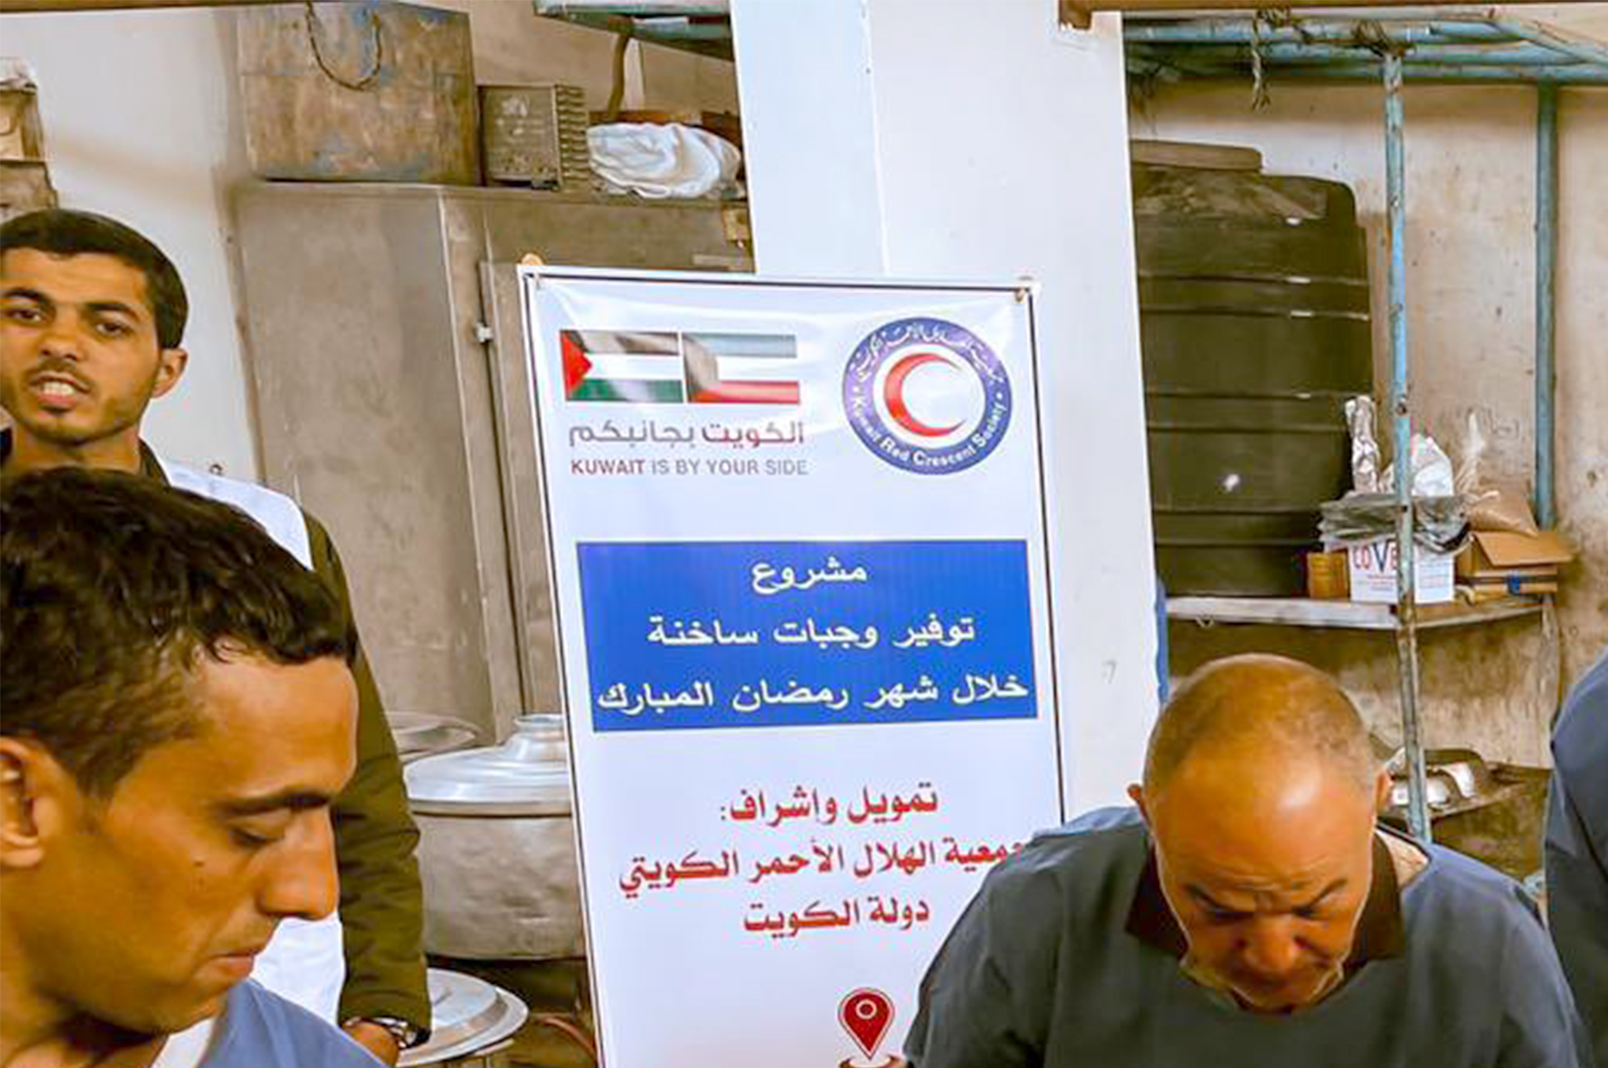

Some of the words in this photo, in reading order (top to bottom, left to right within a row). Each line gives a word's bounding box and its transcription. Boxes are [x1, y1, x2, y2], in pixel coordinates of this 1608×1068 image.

[569, 419, 695, 449] بجانبكم
[701, 420, 804, 449] الكويت
[912, 447, 977, 467] Crescent
[971, 402, 1007, 447] Society
[571, 459, 645, 475] KUWAIT
[652, 459, 670, 475] IS
[675, 459, 700, 475] BY
[706, 459, 759, 475] YOUR
[765, 459, 809, 475] SIDE
[752, 556, 867, 595] مشروع
[647, 615, 759, 645] ساخنة
[773, 614, 879, 649] وجبات
[892, 613, 976, 648] توفير
[597, 681, 714, 715] المبارك
[732, 680, 849, 712] رمضان
[863, 675, 938, 708] شهر
[952, 674, 1029, 705] خلال
[847, 782, 938, 824] تمويل
[618, 850, 739, 899] الكويتي
[749, 838, 844, 884] الأحمر
[853, 841, 935, 879] الهلال
[743, 900, 860, 939] الكويت
[867, 896, 930, 931] دولة
